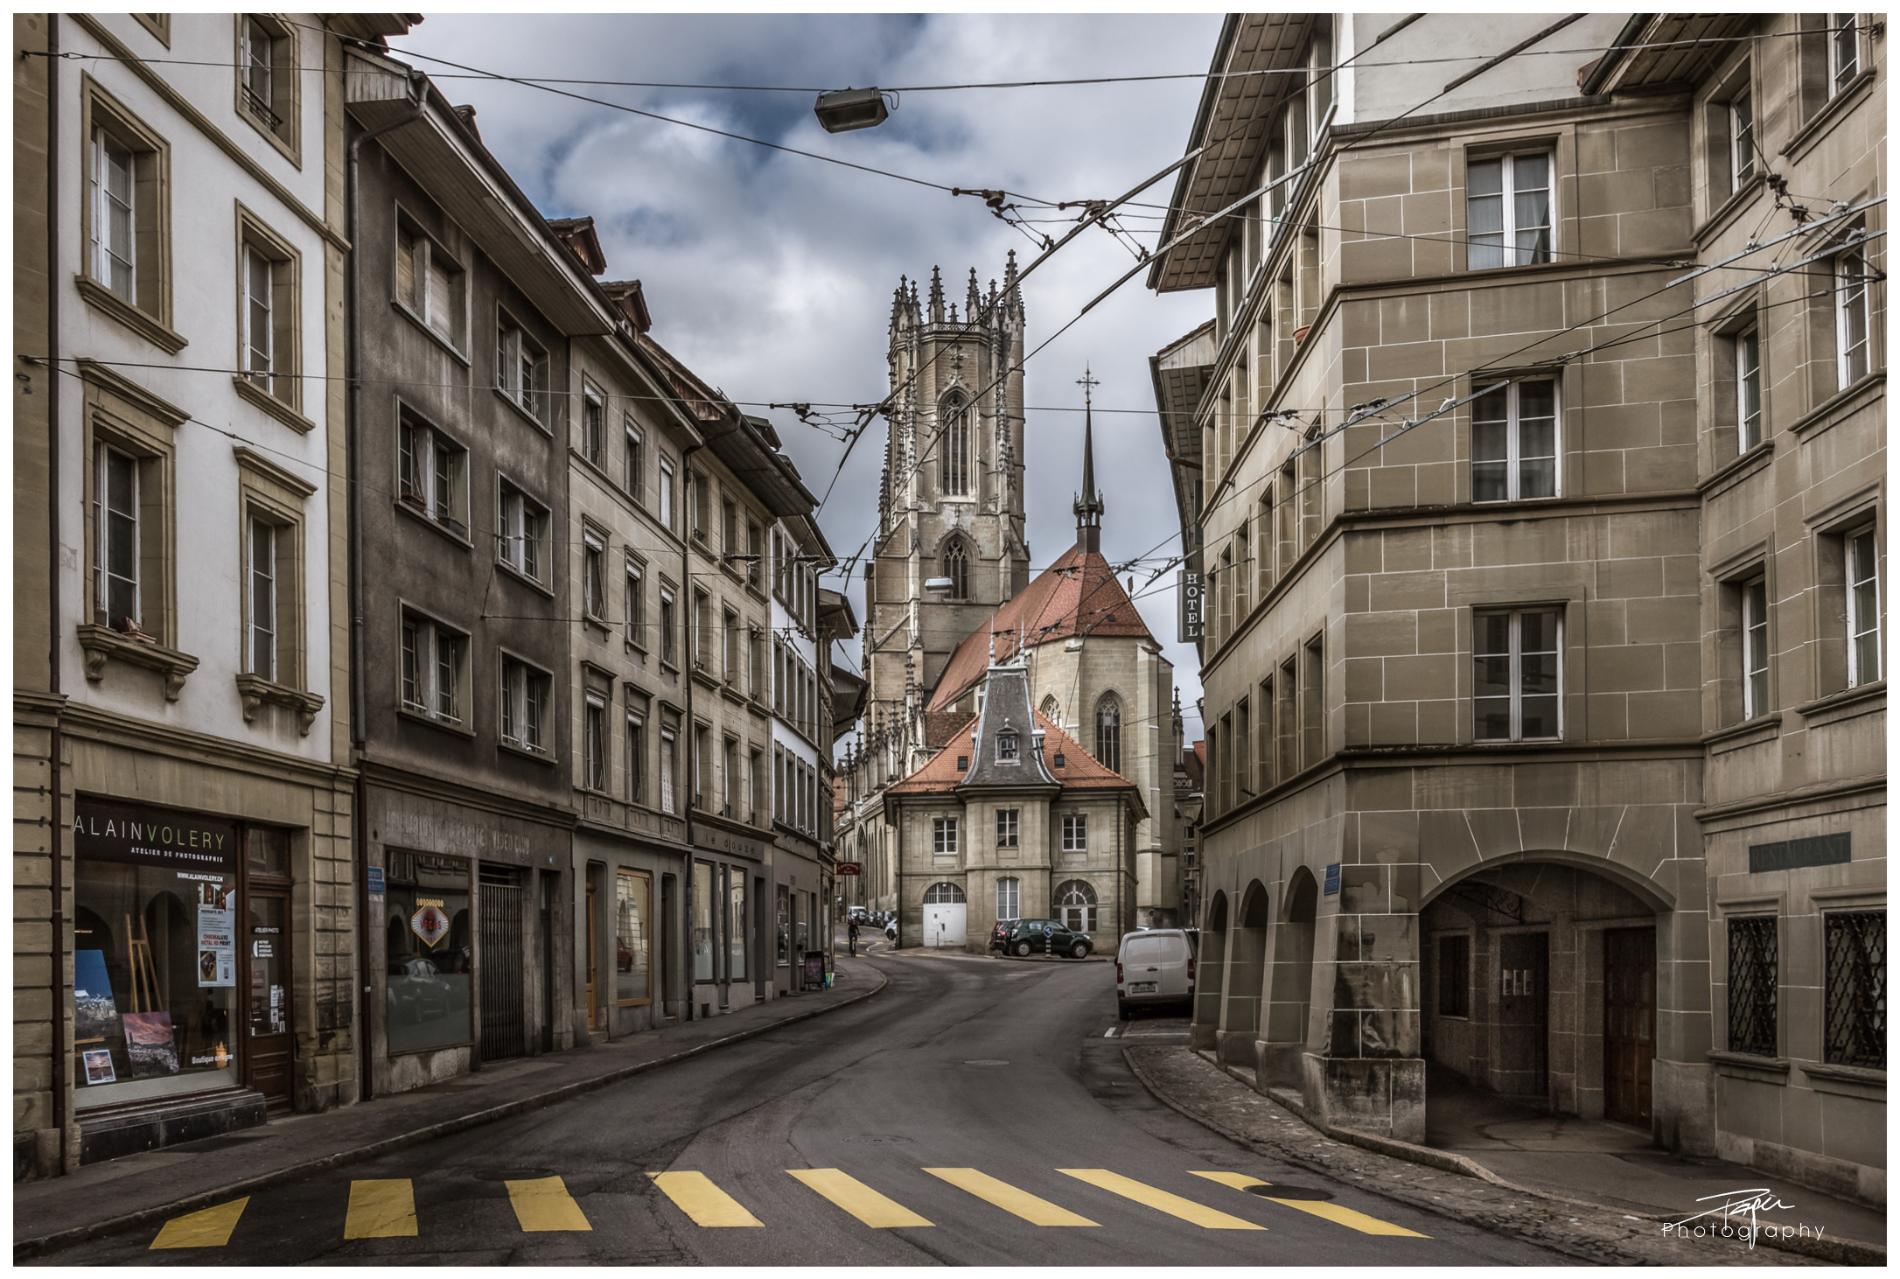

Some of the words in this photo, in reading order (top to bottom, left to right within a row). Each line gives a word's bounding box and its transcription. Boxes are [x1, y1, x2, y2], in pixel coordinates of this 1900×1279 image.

[1186, 573, 1199, 637] HOTEL
[131, 847, 161, 856] ATELIER
[164, 850, 172, 858] DE
[175, 852, 224, 863] PHOTOGRAPHIE
